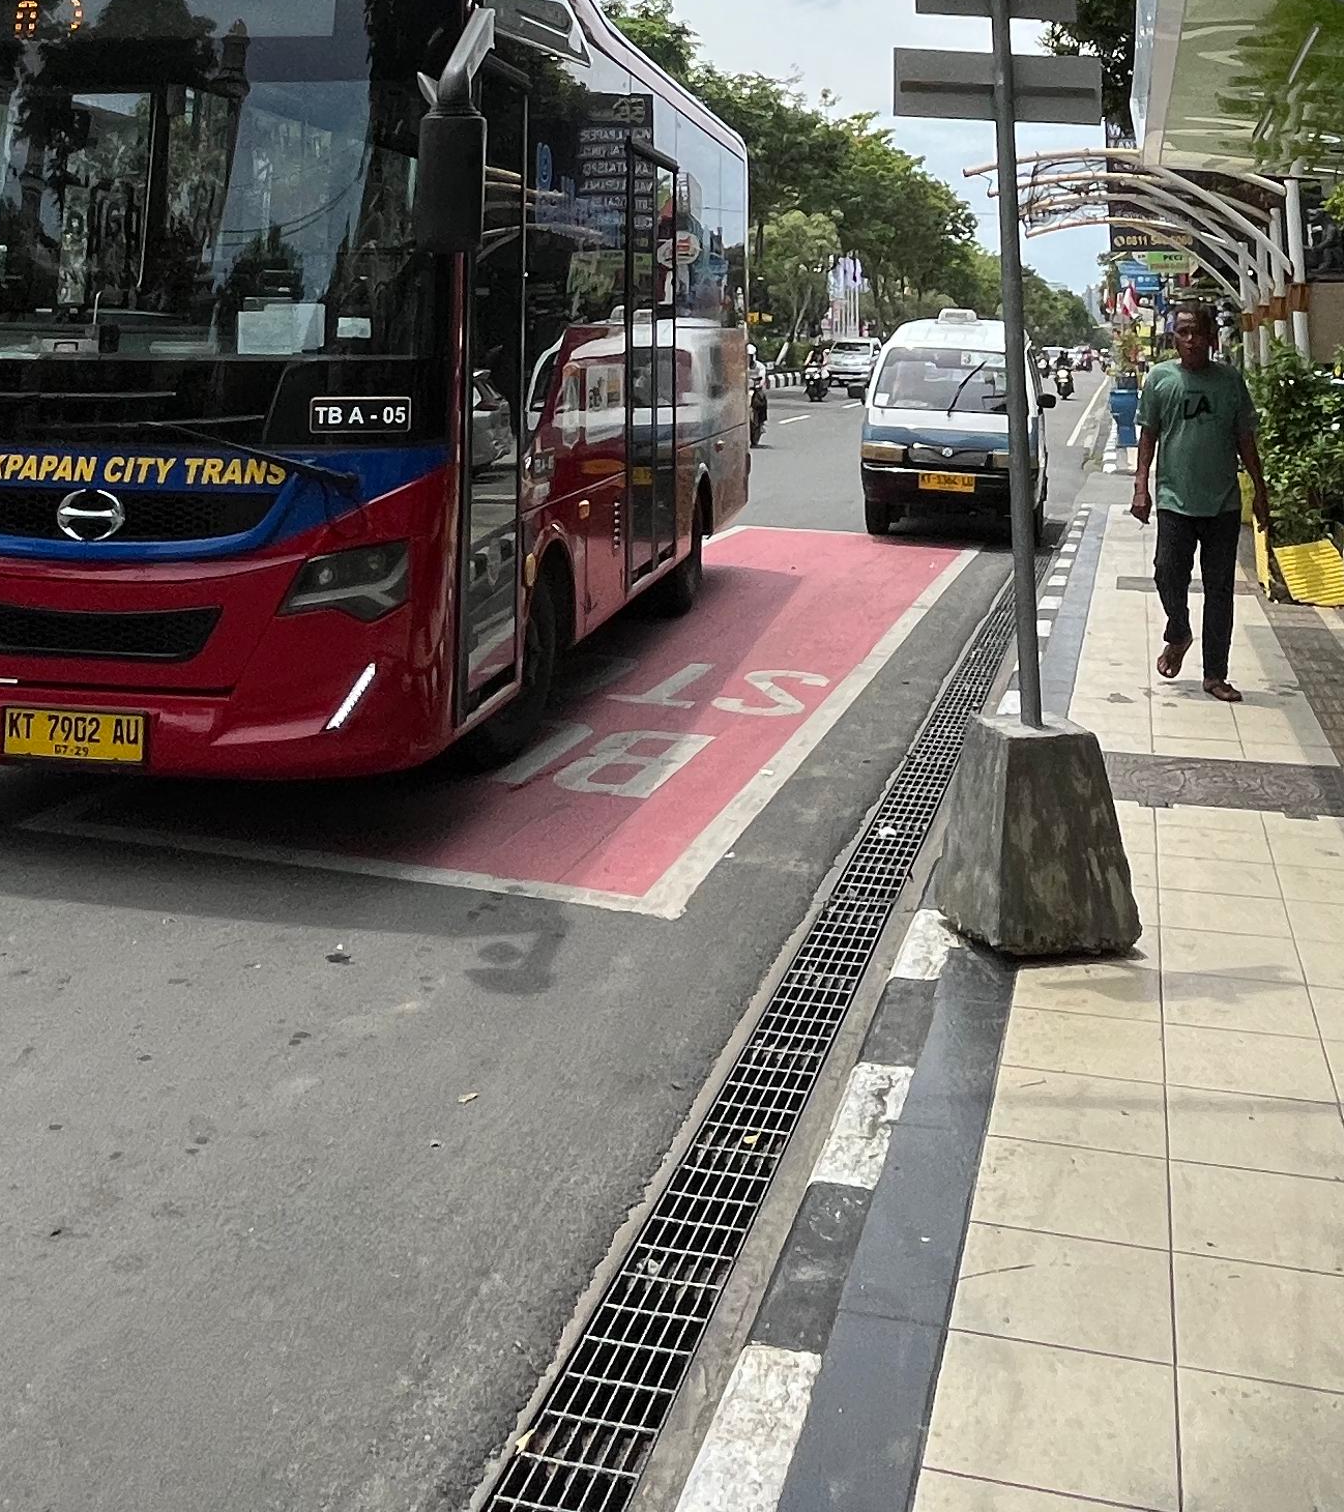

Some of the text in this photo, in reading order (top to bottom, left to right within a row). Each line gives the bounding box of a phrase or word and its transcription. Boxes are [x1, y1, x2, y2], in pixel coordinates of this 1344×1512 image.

[314, 406, 343, 424] TB
[348, 406, 364, 424] A
[382, 406, 406, 424] 05
[1184, 394, 1212, 420] LA
[103, 456, 177, 484] CITY
[184, 458, 286, 485] TRANS
[8, 712, 139, 745] KT 7902 AU
